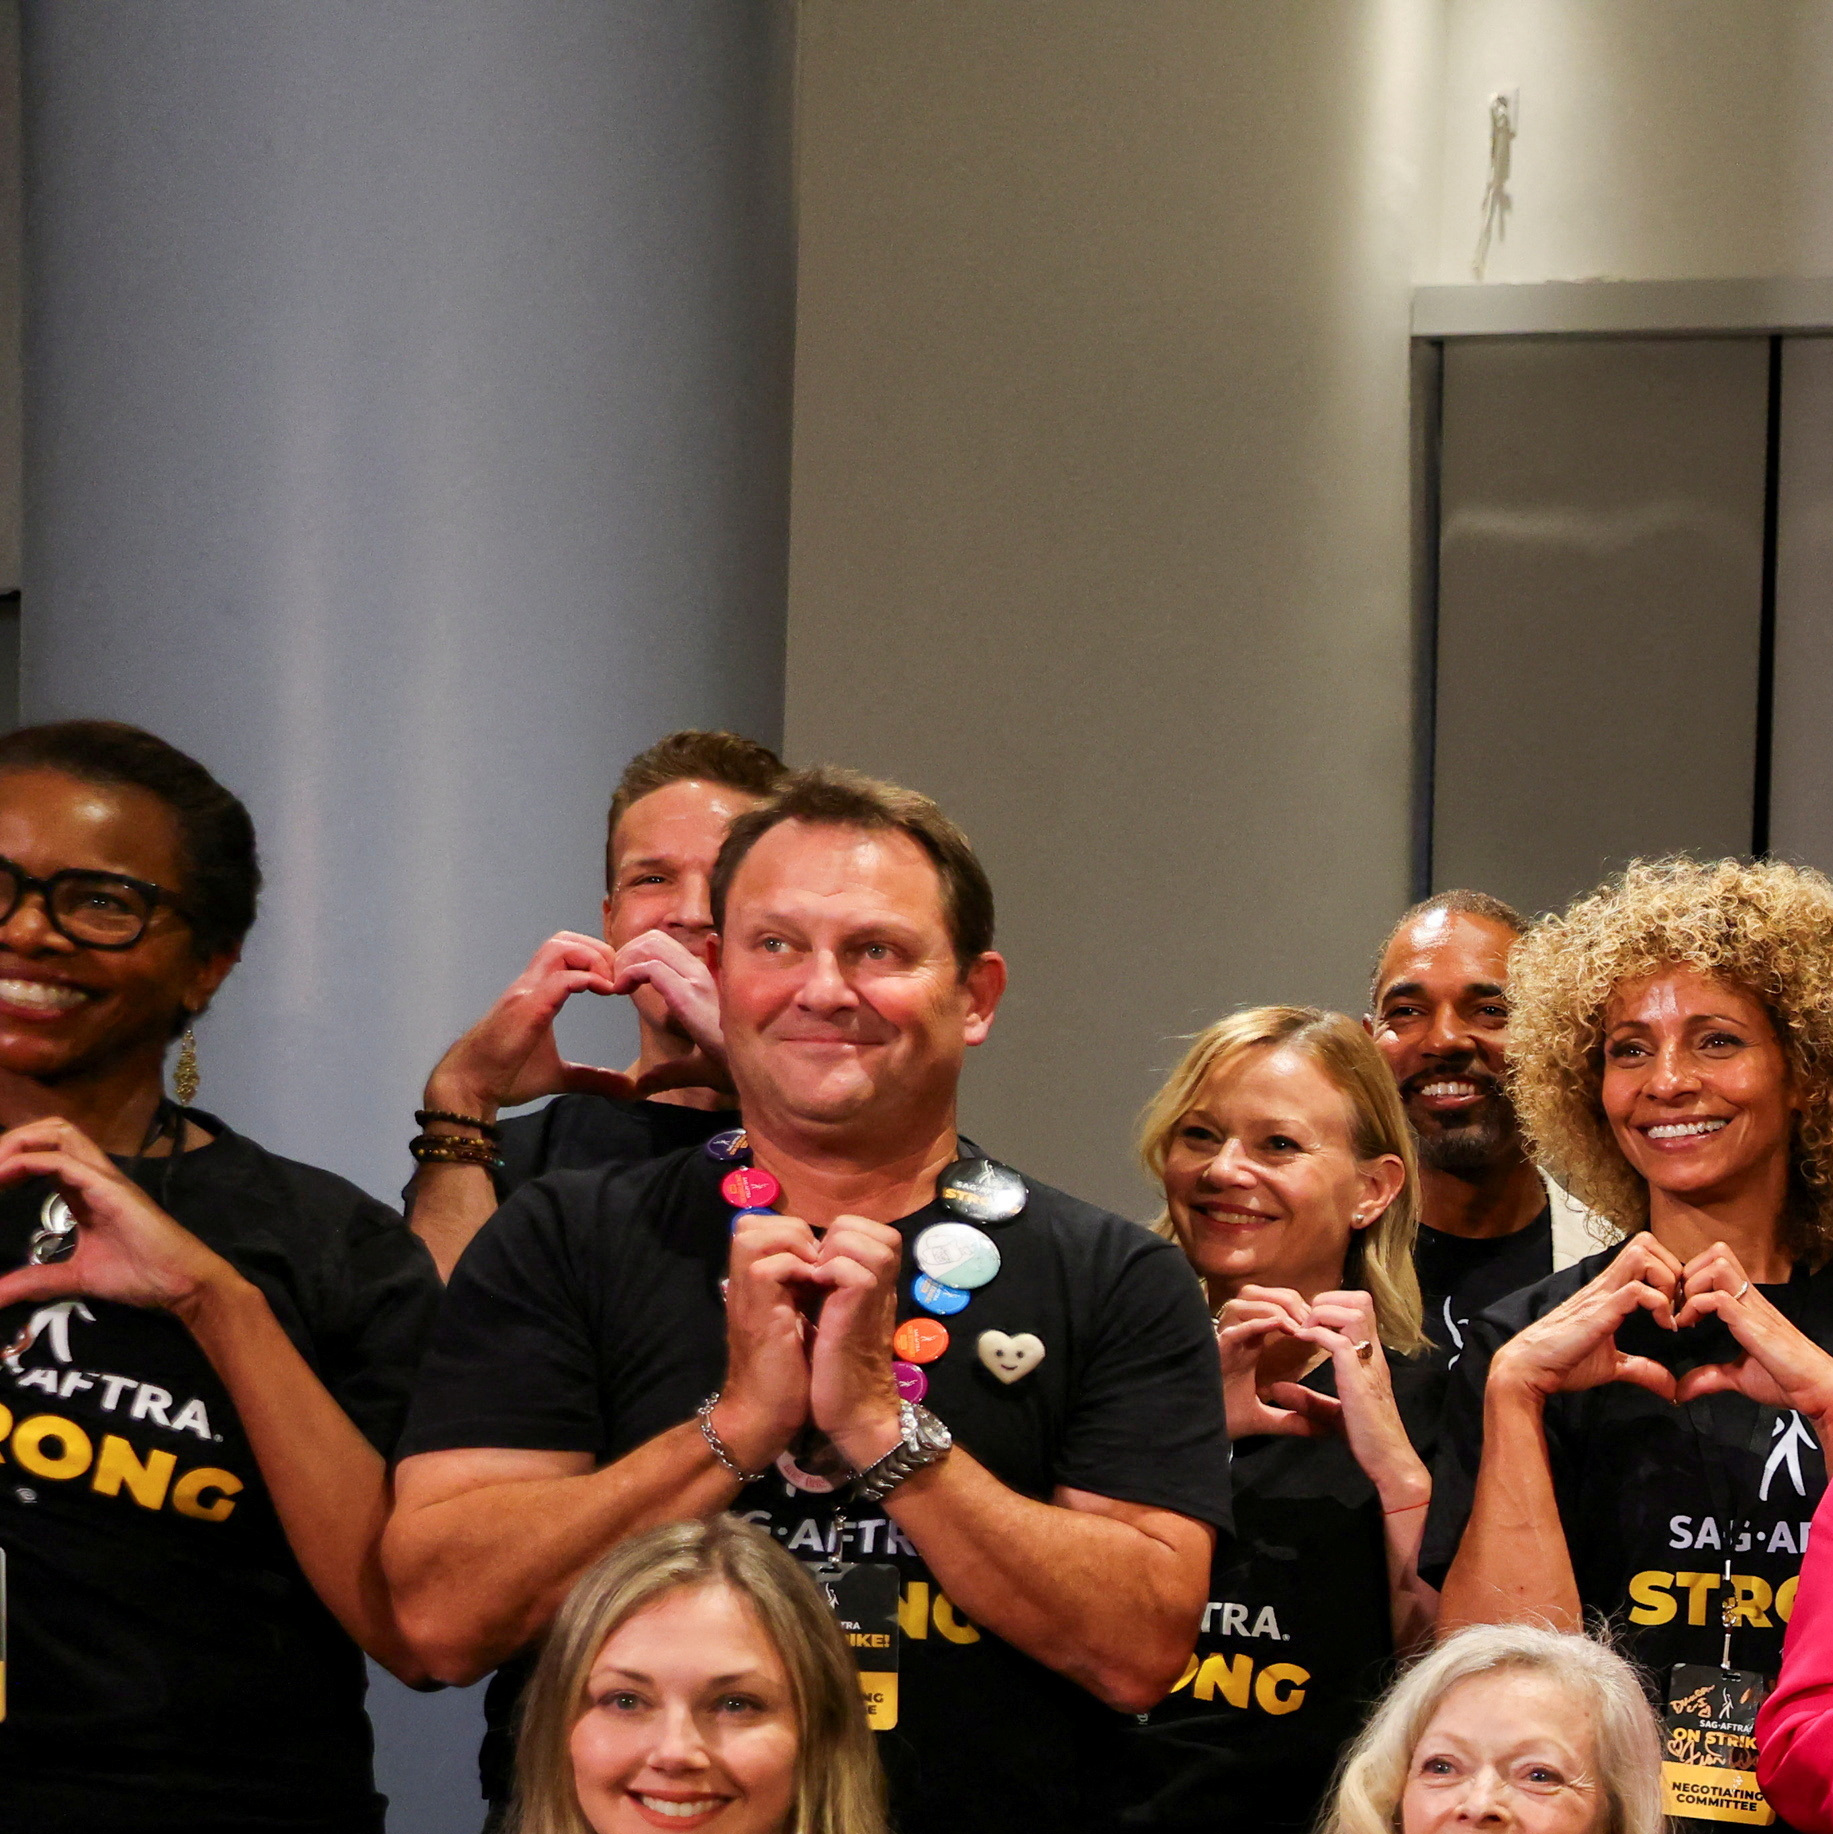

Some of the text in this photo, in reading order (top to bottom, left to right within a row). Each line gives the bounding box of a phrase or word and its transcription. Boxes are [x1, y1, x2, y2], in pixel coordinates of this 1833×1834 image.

[1672, 1727, 1701, 1743] ON
[1672, 1781, 1764, 1801] NEGOTIATING
[1676, 1793, 1758, 1812] COMMITTEE
